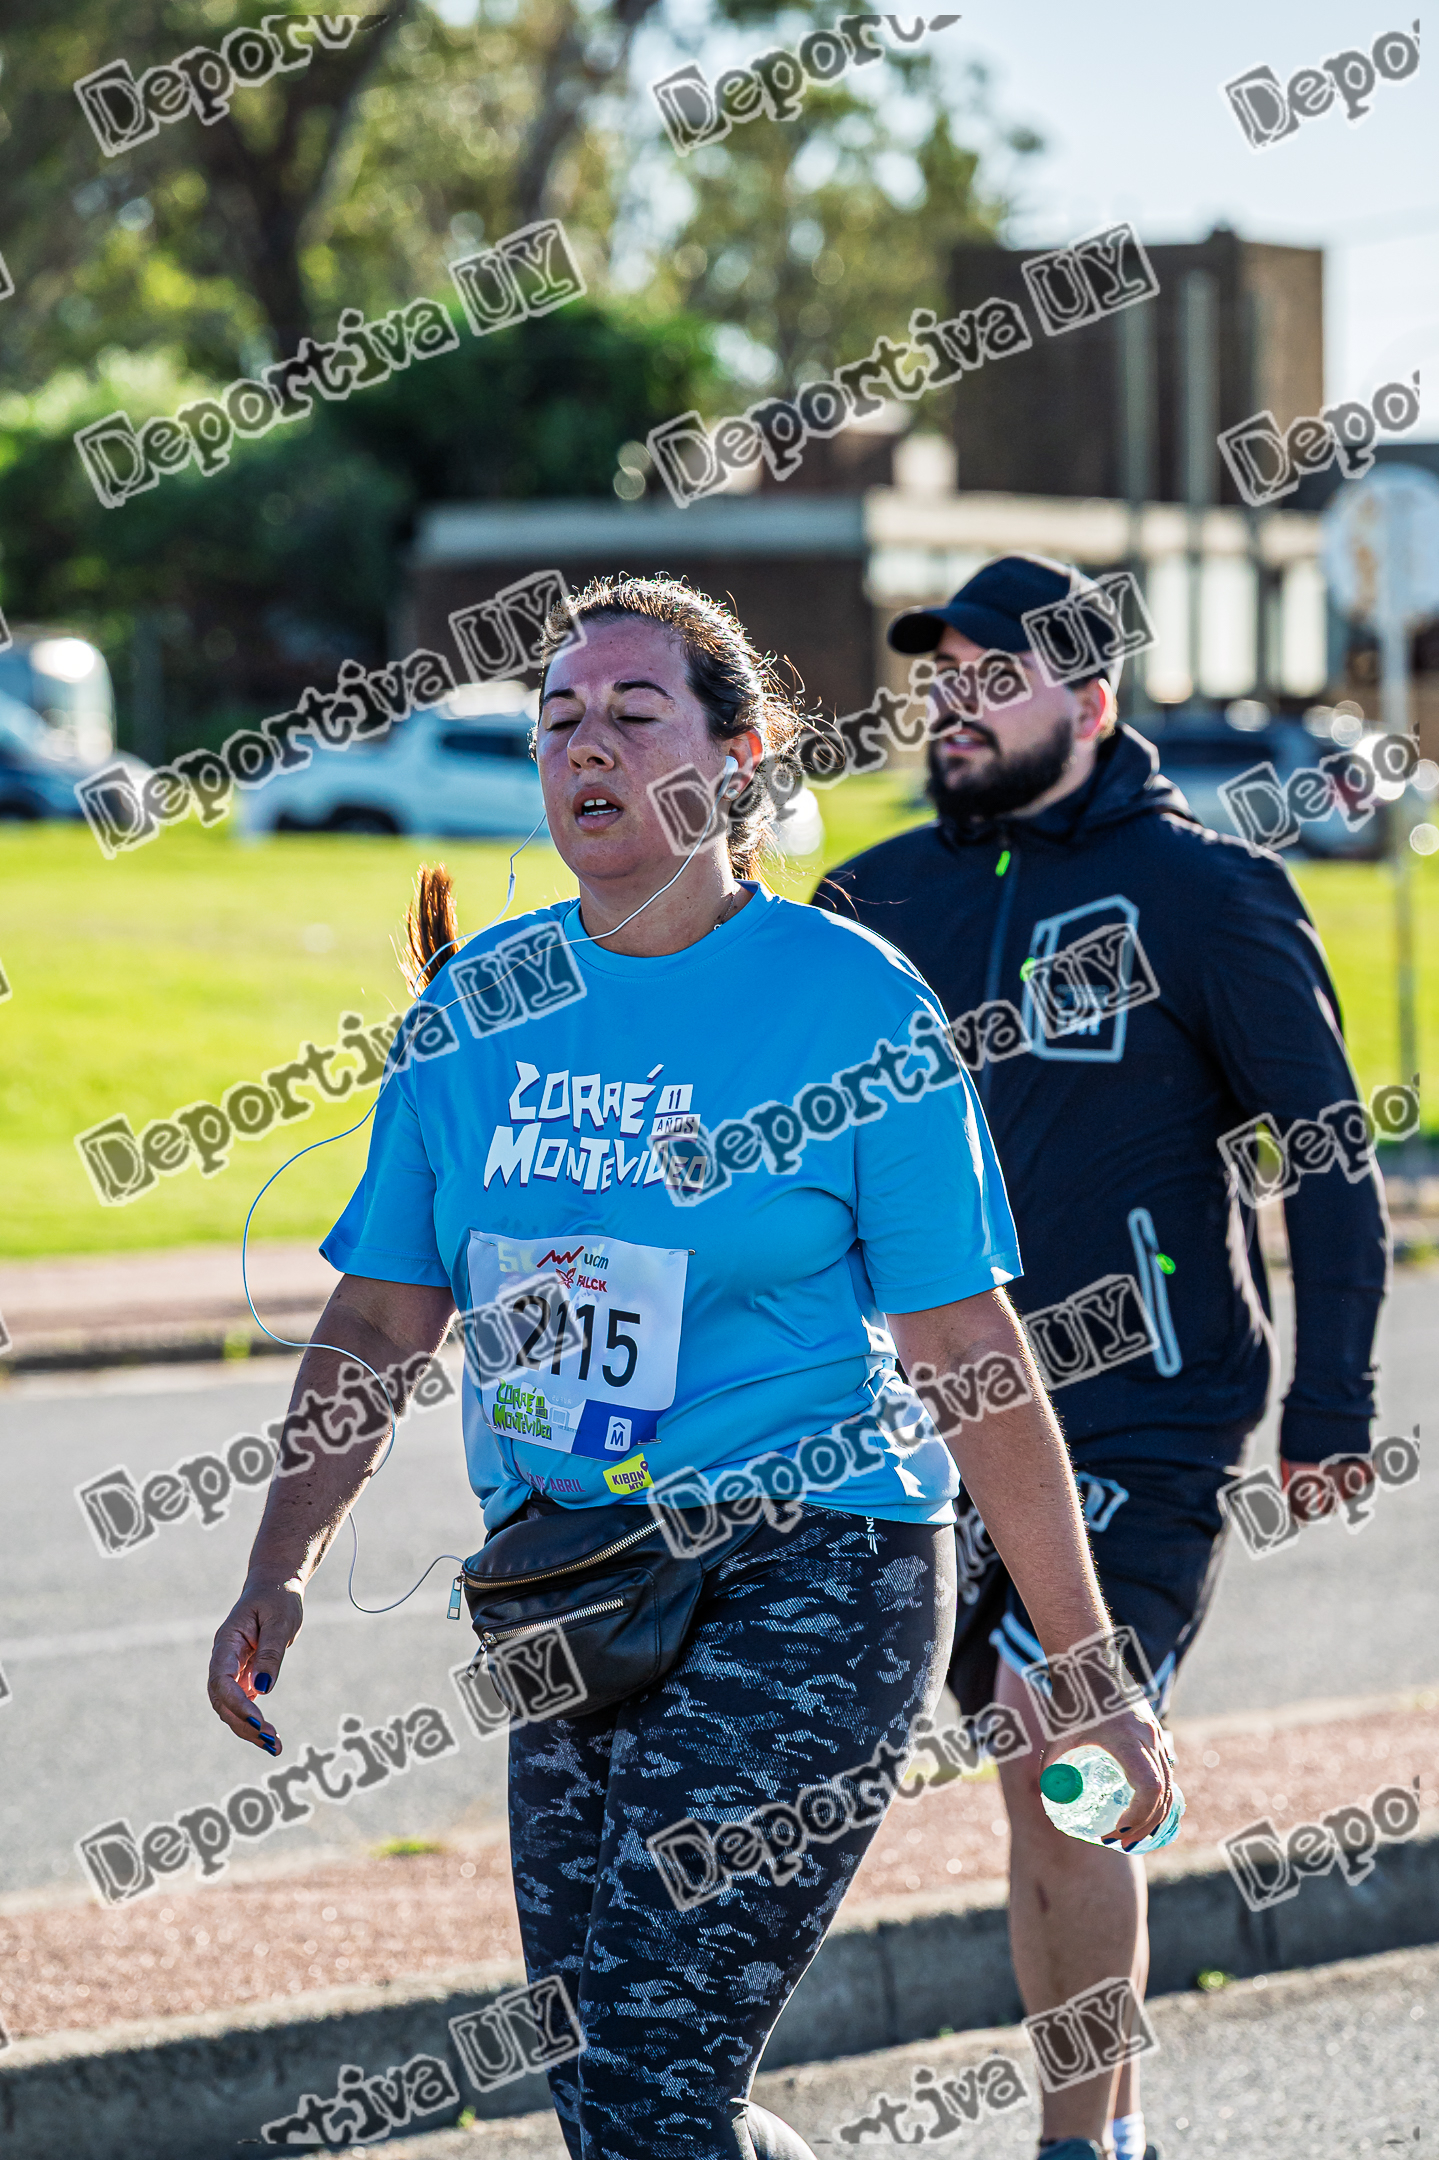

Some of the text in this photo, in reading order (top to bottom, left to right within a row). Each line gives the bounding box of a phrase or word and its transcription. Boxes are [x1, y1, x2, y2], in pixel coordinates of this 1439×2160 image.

[584, 1252, 609, 1270] ucm
[576, 1274, 608, 1292] FALCK
[513, 1295, 641, 1388] 2115
[550, 1477, 586, 1493] ABRIL
[611, 1470, 645, 1486] KIBON
[628, 1480, 644, 1491] MTV
